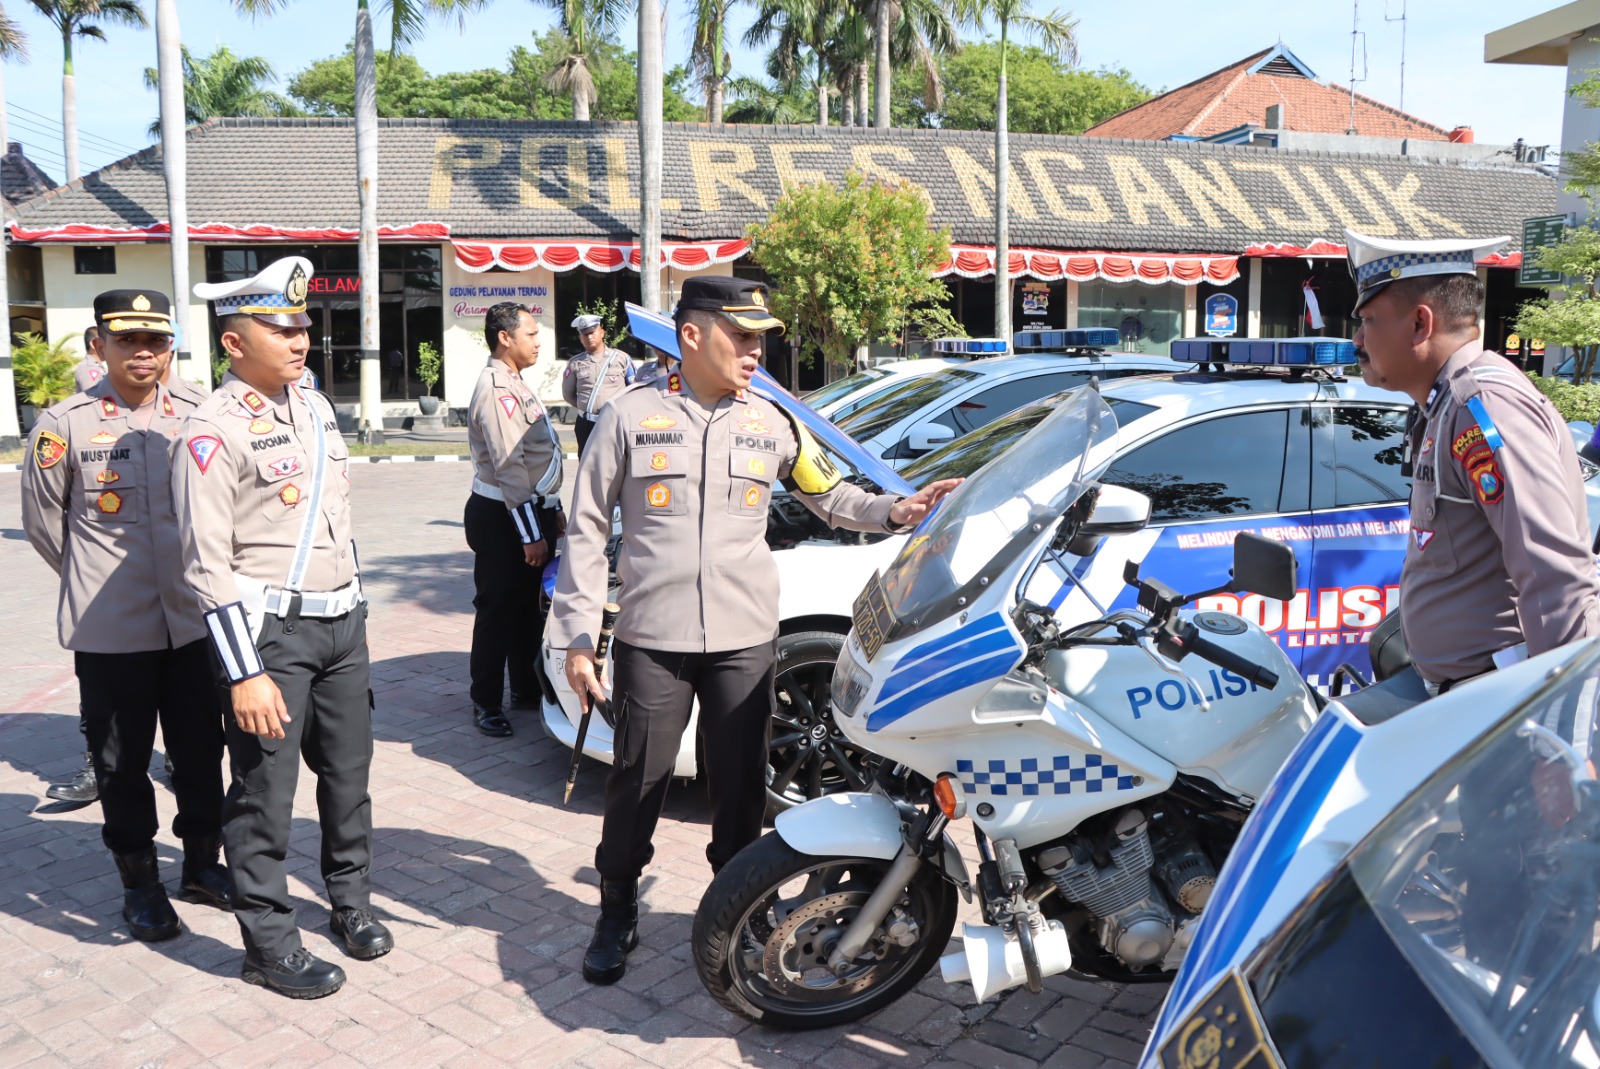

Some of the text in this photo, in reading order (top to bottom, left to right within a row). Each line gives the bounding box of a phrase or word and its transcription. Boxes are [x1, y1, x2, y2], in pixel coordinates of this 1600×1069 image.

[430, 137, 1470, 237] POLRES NGANJUK
[449, 287, 547, 297] GEDUNG PELAYANAN TERPADU
[635, 432, 683, 446] MUHAMMAD
[735, 435, 776, 452] POLRI
[1453, 427, 1481, 453] POLRE
[80, 448, 130, 463] MUSTIJAT
[1177, 518, 1412, 549] MELINDU MENGAYOMI DAN MELAYA
[1287, 630, 1373, 648] LINT
